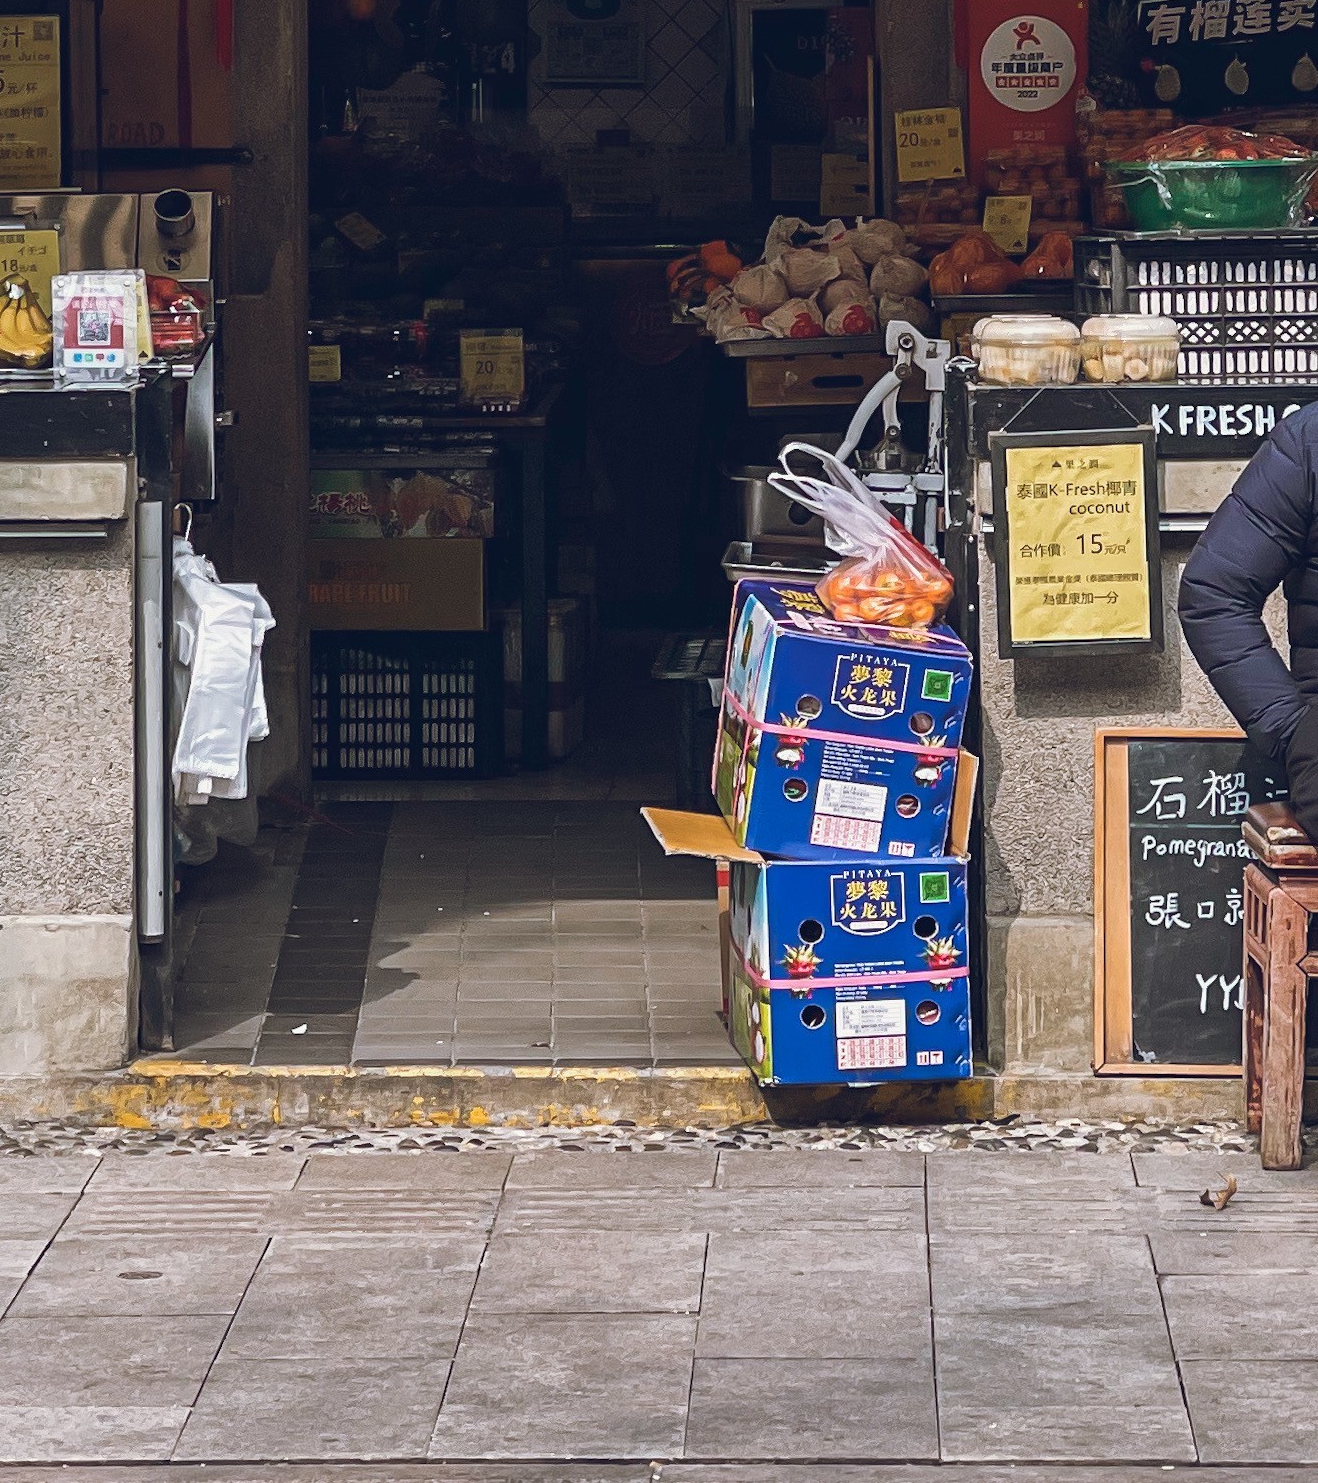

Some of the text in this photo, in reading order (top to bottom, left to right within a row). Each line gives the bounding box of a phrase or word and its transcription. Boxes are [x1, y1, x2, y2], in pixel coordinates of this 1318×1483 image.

[1017, 90, 1038, 98] 2022
[1069, 501, 1130, 515] coconut
[850, 652, 898, 667] PITAYA
[840, 685, 898, 707] 火龙果
[1141, 835, 1260, 868] Pomegrana
[843, 869, 892, 879] PITAYA
[840, 901, 897, 920] 火龙果
